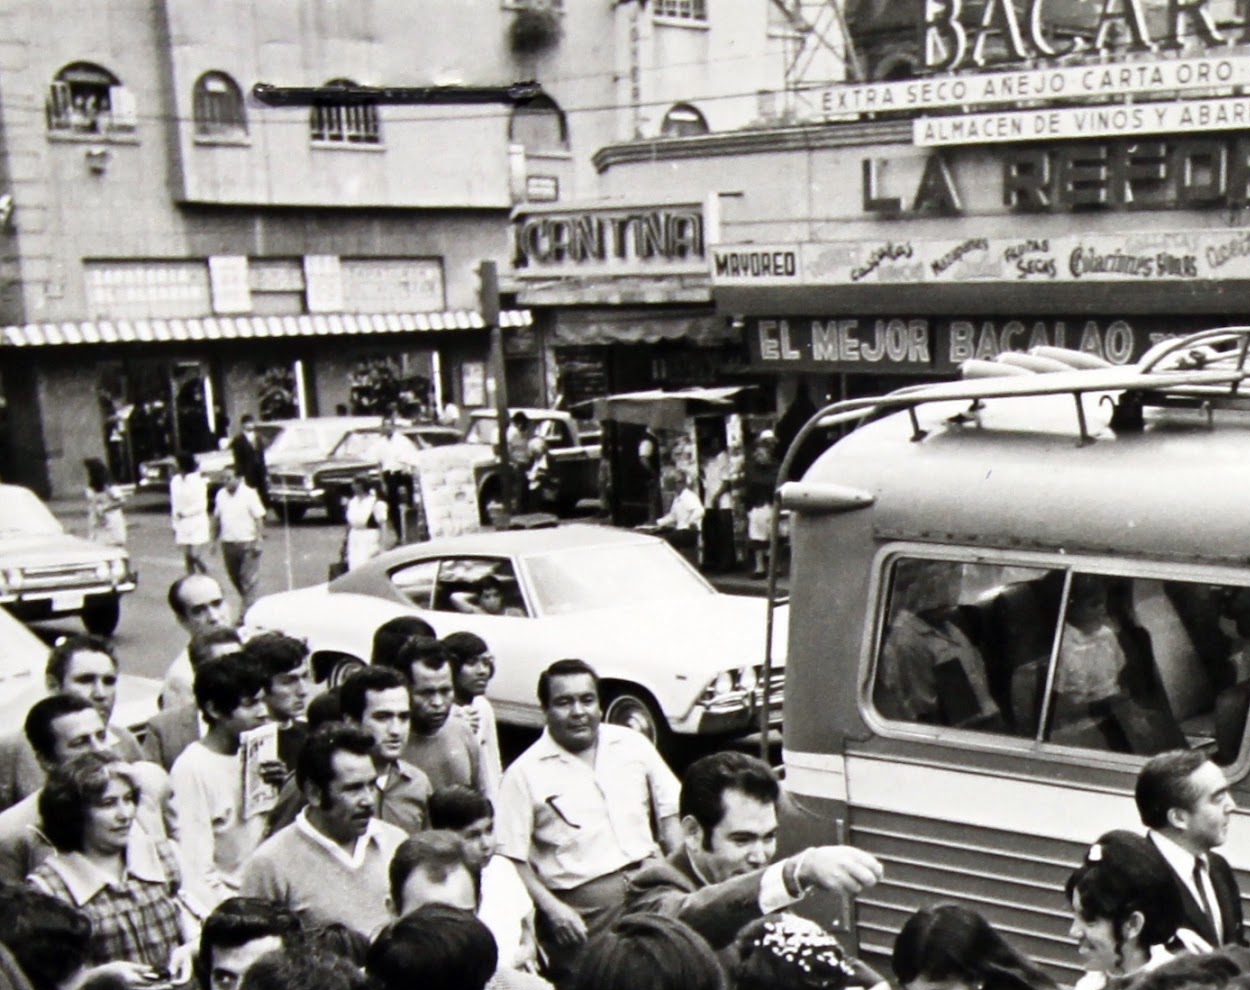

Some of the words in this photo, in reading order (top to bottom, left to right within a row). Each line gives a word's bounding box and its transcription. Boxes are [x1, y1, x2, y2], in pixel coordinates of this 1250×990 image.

[821, 87, 893, 111] EXTRA
[907, 81, 967, 103] SECO
[984, 73, 1066, 96] AÑEJO
[1082, 64, 1163, 91] CARTA
[1177, 61, 1233, 84] ORO
[924, 116, 1022, 141] ALMACEN
[1034, 114, 1060, 134] DE
[1074, 109, 1143, 131] VINOS
[1153, 106, 1165, 126] Y
[861, 155, 962, 216] LA
[519, 211, 704, 264] CANTINA
[714, 252, 796, 277] MAYOREO
[758, 320, 800, 360] EL
[811, 319, 930, 362] MEJOR
